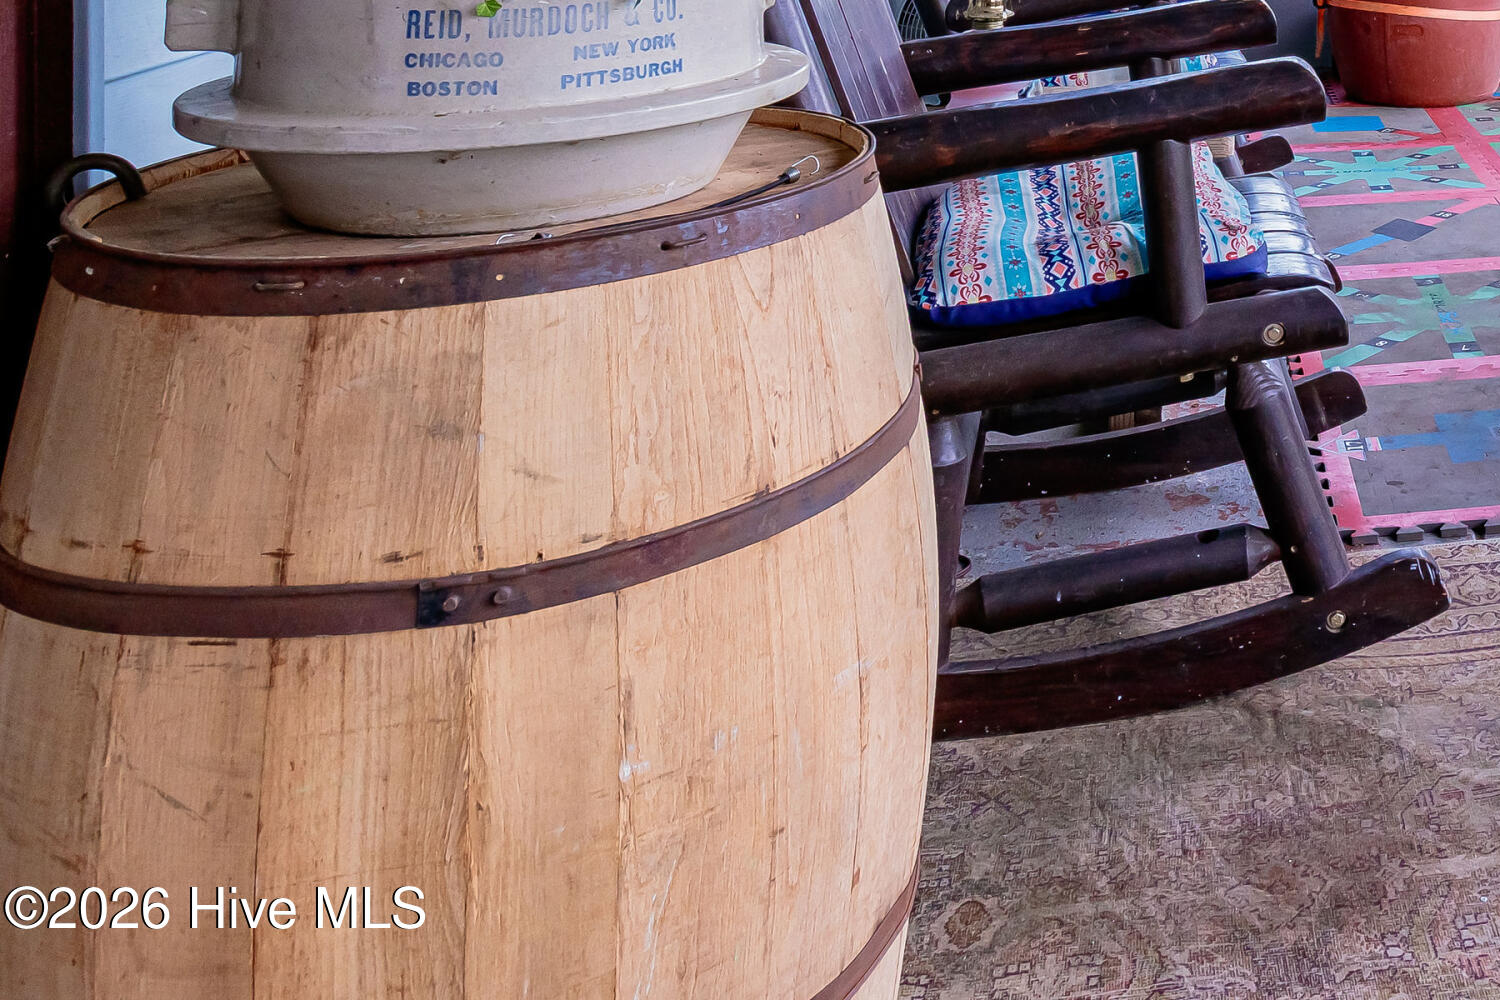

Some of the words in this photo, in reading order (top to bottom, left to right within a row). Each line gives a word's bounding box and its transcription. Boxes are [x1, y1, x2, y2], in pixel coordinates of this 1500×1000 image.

[406, 9, 472, 43] REID,
[488, 1, 610, 39] MURDOCH
[622, 1, 641, 27] &
[404, 52, 504, 69] CHICAGO
[573, 40, 618, 61] NEW
[627, 33, 676, 54] YORK
[407, 79, 498, 97] BOSTON
[560, 58, 683, 90] PITTSBURGH
